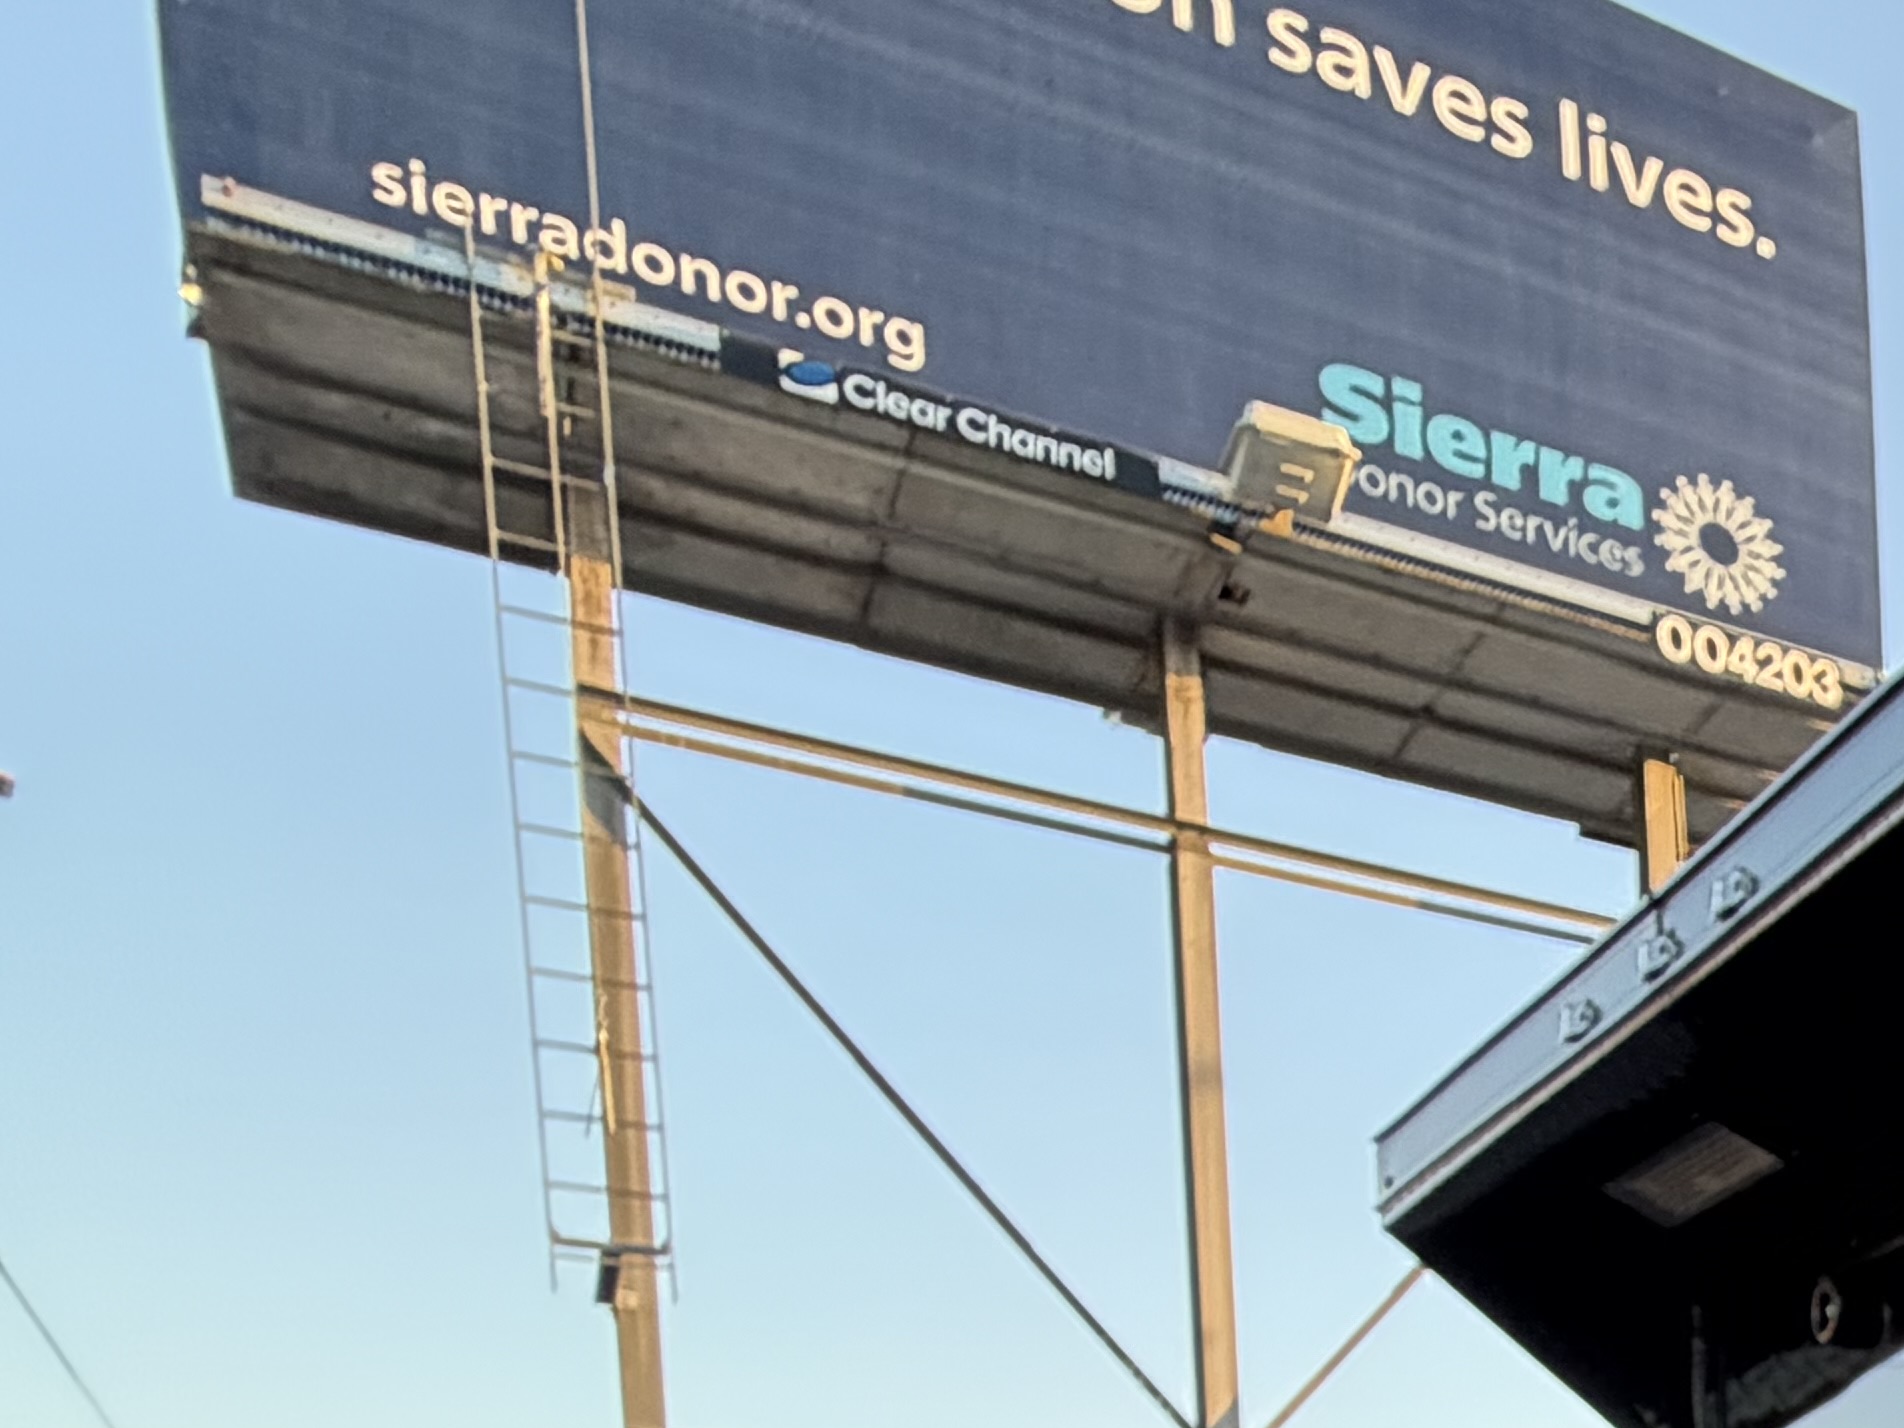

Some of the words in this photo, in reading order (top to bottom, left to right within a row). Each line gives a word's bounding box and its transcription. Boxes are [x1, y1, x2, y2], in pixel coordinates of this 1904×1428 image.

[1265, 7, 1533, 159] saves
[1558, 97, 1777, 260] lives.
[369, 157, 928, 373] sierradonor.org
[842, 373, 953, 432] Clear
[956, 407, 1117, 481] Channel
[1318, 363, 1646, 532] Sierra
[1349, 464, 1466, 520] onor
[1474, 490, 1646, 578] Services
[1654, 612, 1845, 711] 004203
